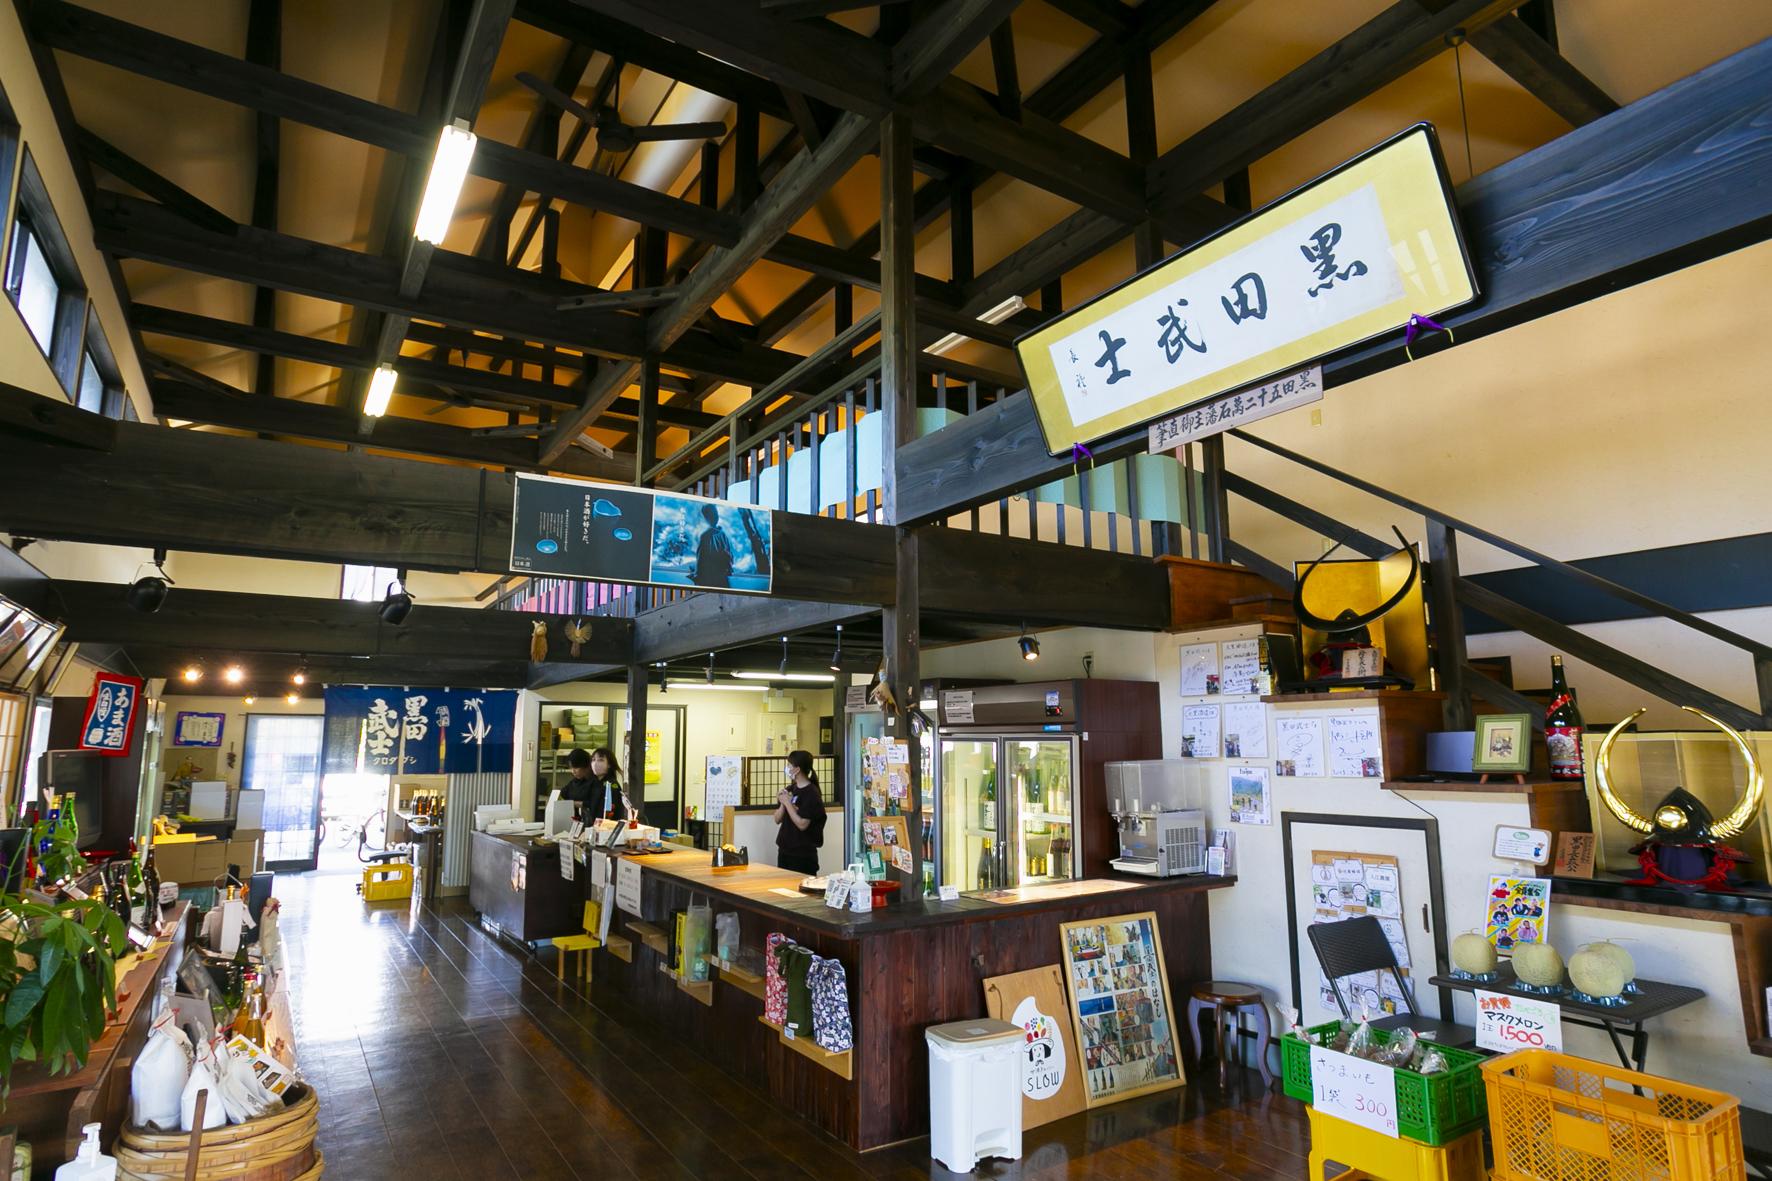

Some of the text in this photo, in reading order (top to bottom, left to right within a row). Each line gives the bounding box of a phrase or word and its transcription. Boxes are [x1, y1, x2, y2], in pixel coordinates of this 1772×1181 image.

[104, 688, 129, 747] あま酒
[366, 696, 430, 756] 黒田 武士
[372, 754, 417, 765] クロダブシ
[1484, 1011, 1544, 1031] マスクメロン
[1027, 1071, 1060, 1092] SLOW
[1316, 1057, 1375, 1085] さつまいも
[1354, 1093, 1387, 1117] 300
